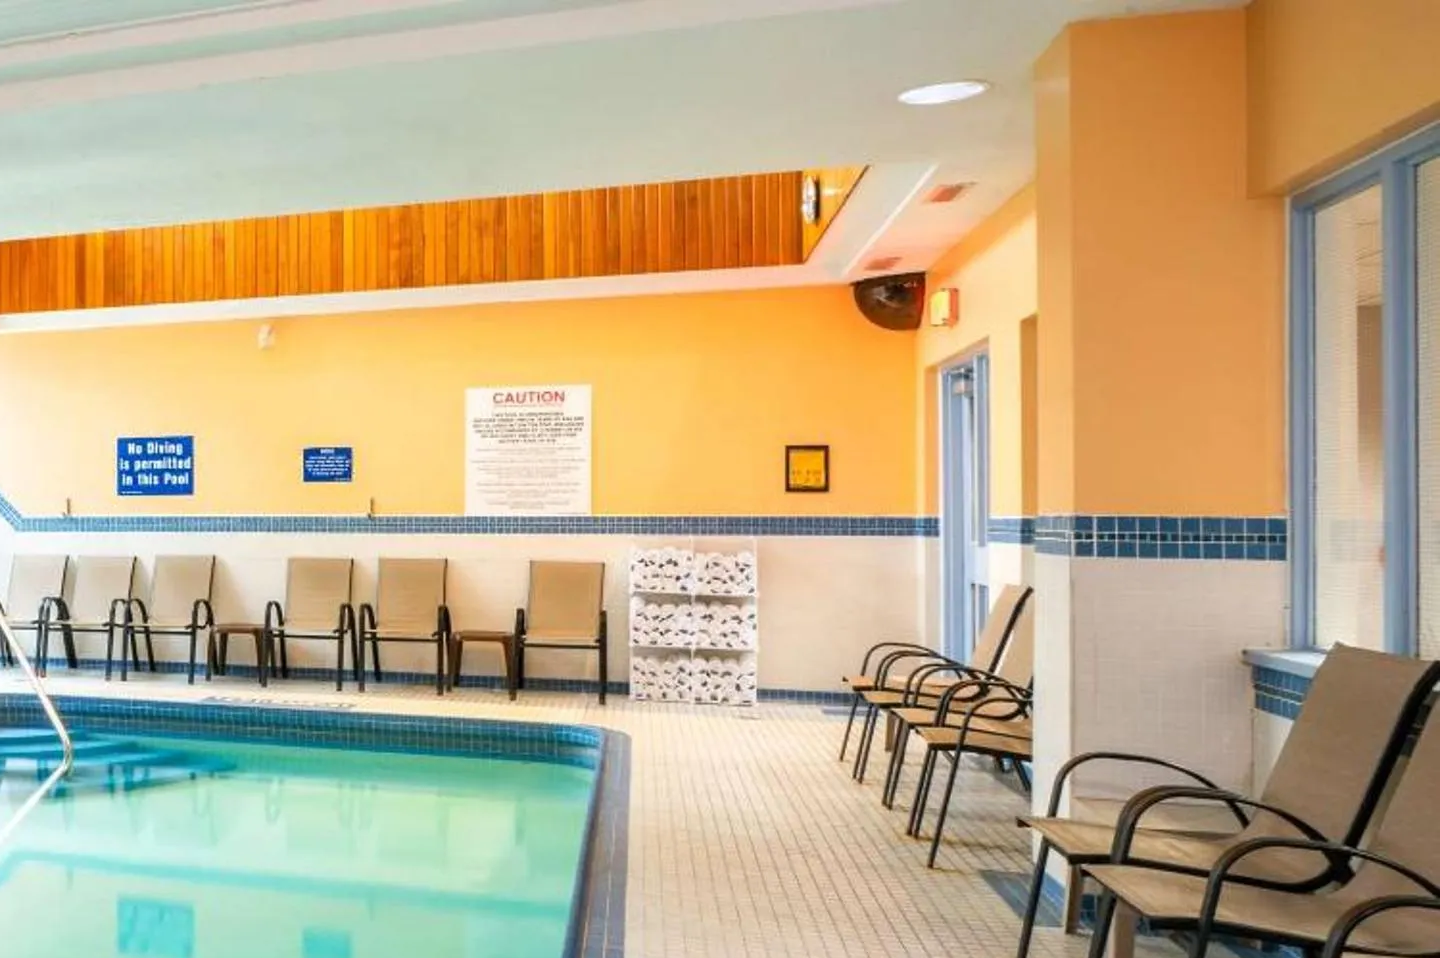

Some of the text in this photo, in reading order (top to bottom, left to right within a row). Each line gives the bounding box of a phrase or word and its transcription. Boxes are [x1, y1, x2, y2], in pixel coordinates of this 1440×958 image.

[493, 391, 565, 404] CAUTION
[128, 442, 184, 456] No Diving
[120, 456, 191, 472] is permitted
[122, 472, 189, 486] in this Pool
